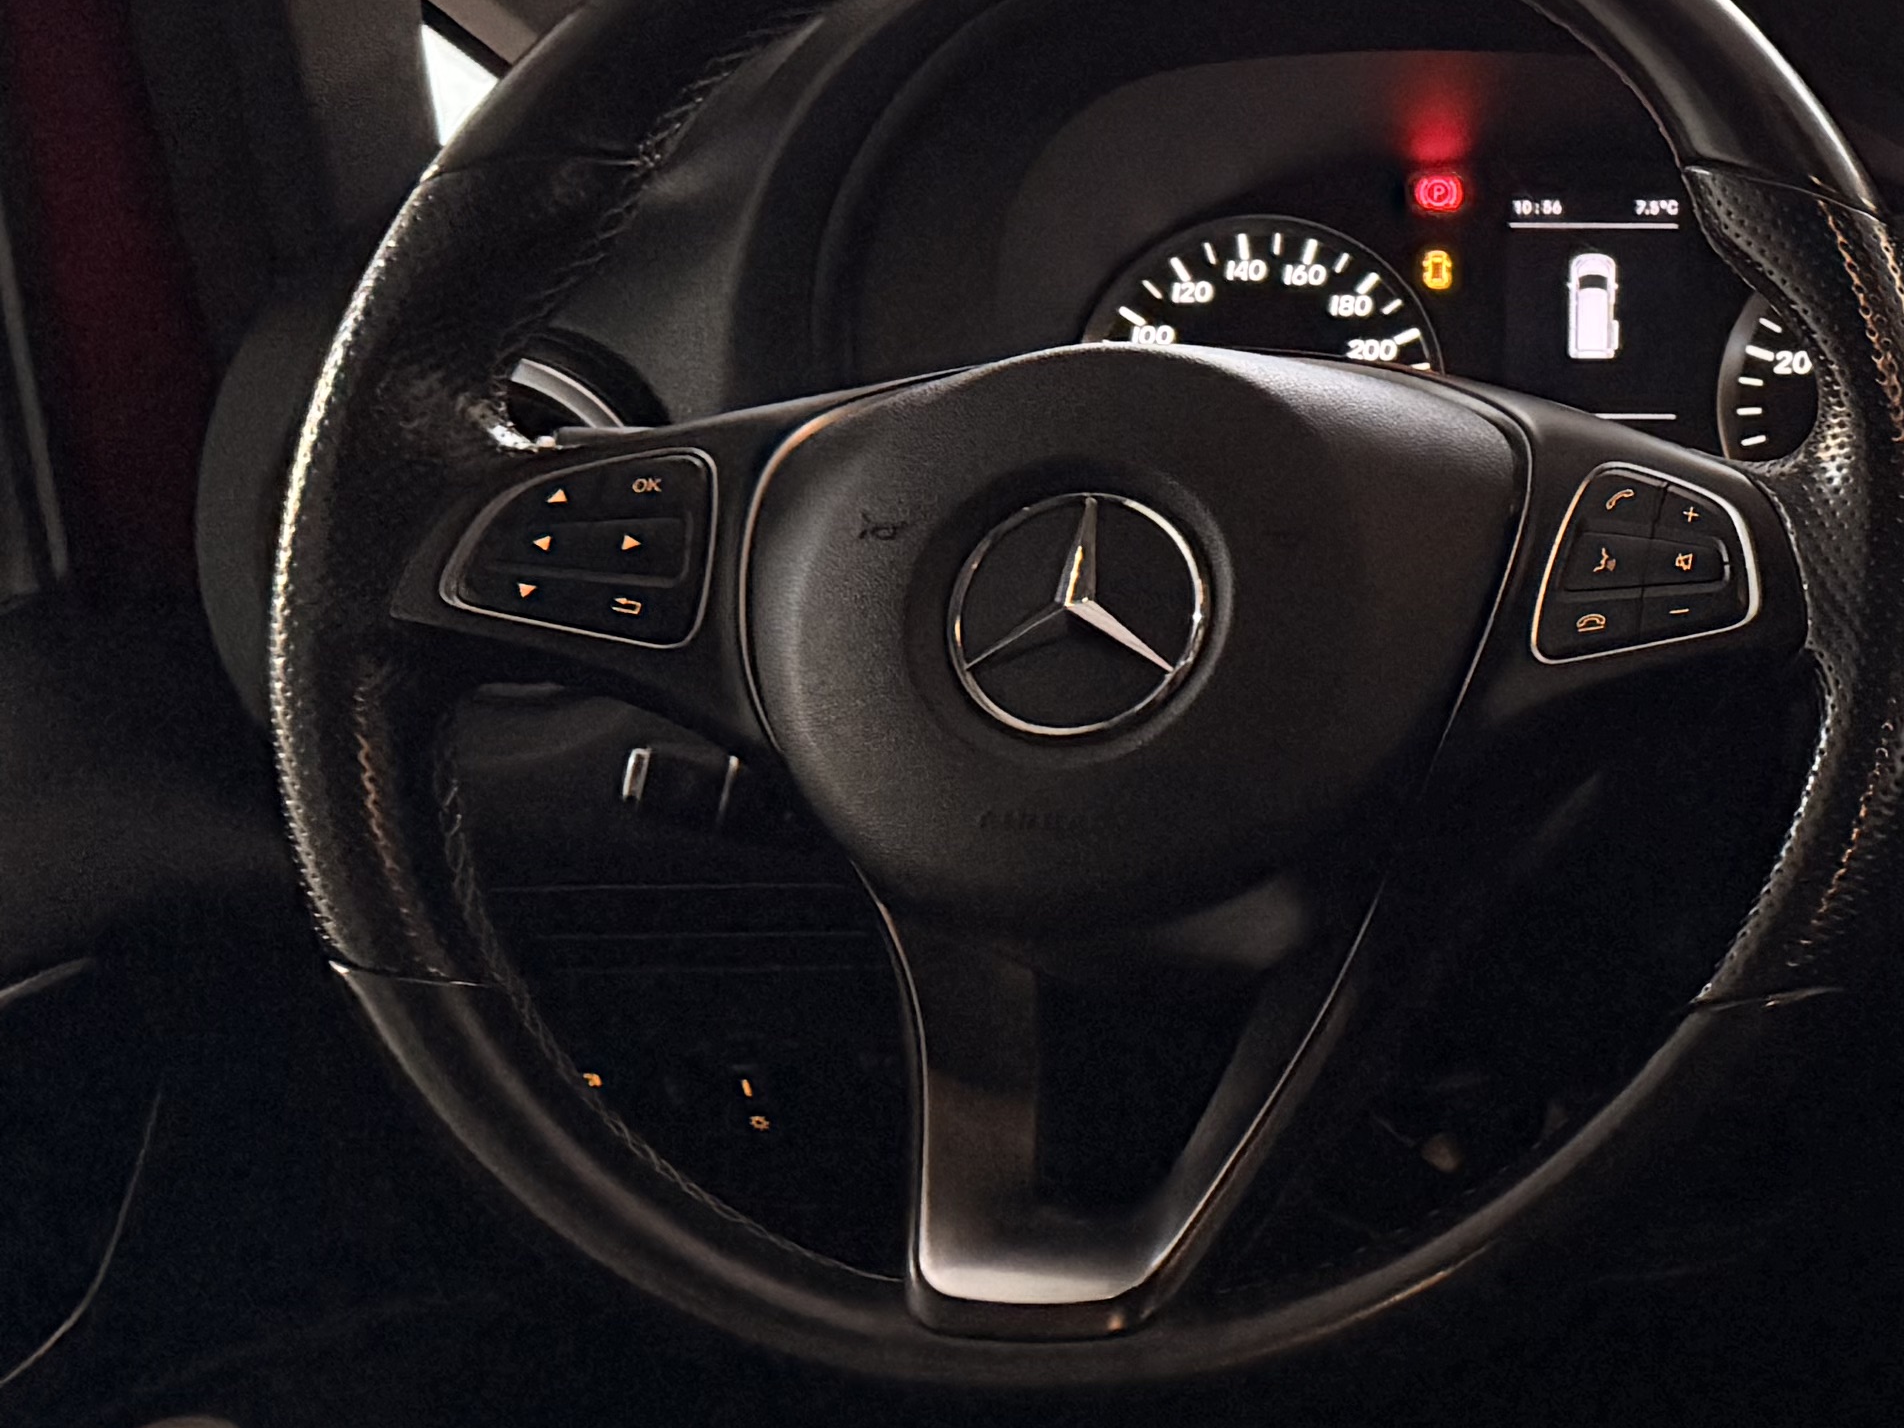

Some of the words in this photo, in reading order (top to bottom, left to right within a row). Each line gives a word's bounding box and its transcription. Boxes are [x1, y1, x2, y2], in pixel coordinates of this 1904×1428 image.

[1226, 259, 1266, 281] 140
[1283, 264, 1326, 286] 160
[1172, 281, 1213, 303] 120
[1330, 294, 1373, 317] 180
[1131, 325, 1176, 345] 100
[1347, 339, 1398, 361] 200
[1773, 350, 1813, 375] 20
[632, 478, 662, 493] OK
